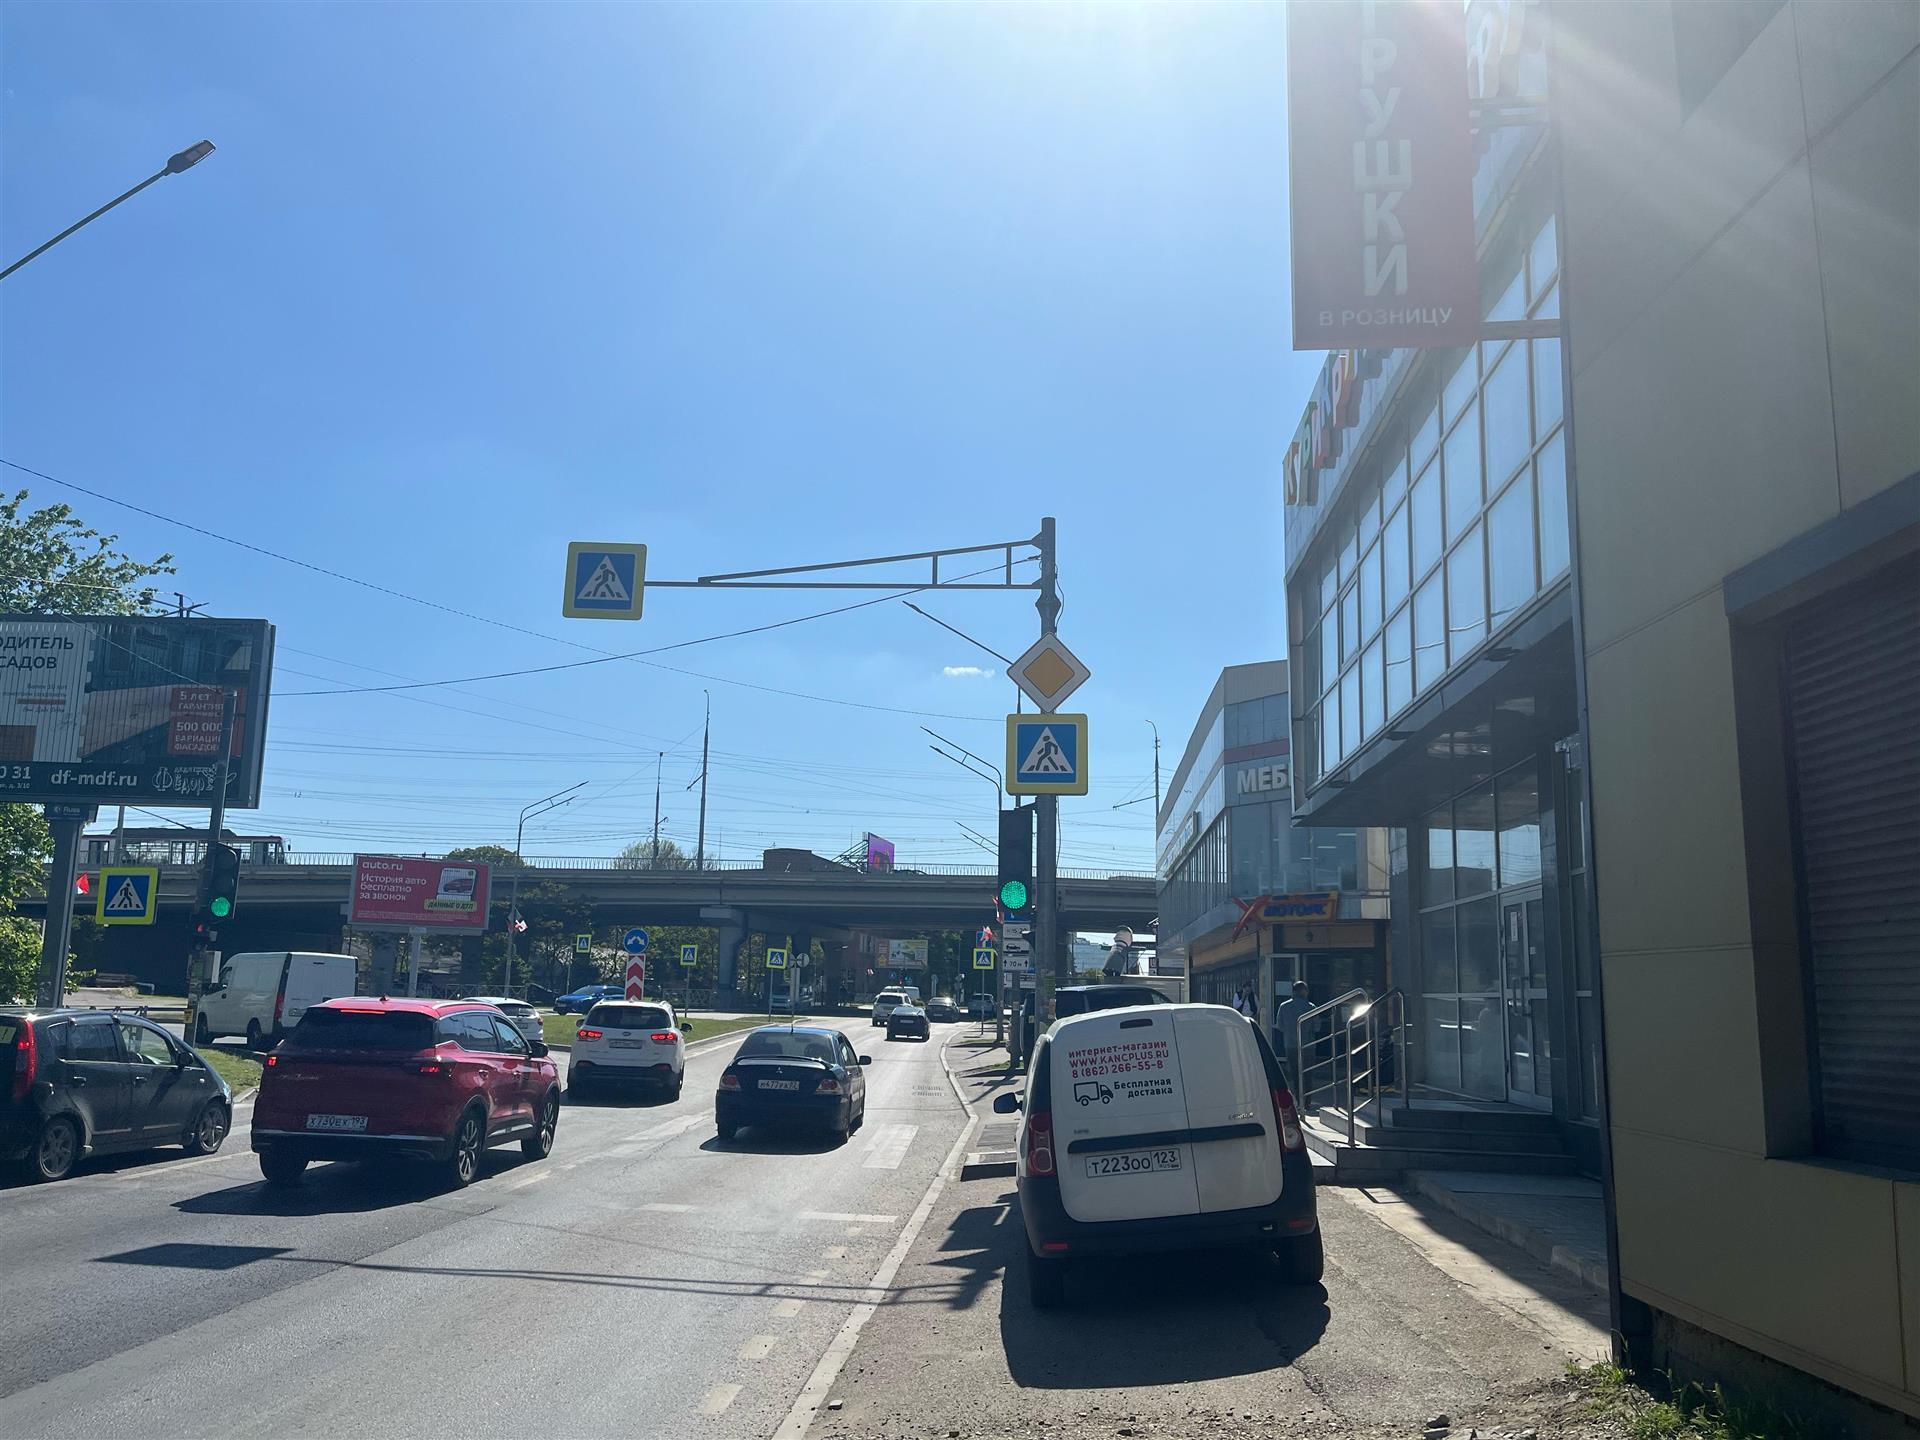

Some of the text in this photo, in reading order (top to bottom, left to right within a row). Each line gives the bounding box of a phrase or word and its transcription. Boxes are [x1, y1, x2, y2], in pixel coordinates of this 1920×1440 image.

[1319, 307, 1453, 327] В РОЗНИЦУ
[0, 636, 74, 651] ДИТЕЛЬ
[176, 721, 199, 732] 500
[12, 766, 31, 779] 31
[51, 769, 138, 786] df-mdf.ru
[1237, 763, 1291, 795] МЕБ
[362, 861, 403, 871] auto.ru
[361, 873, 427, 886] История авто
[1069, 1041, 1167, 1058] интернет-магазин
[1070, 1050, 1169, 1068] WWW.KANCPLUS.RU
[1072, 1060, 1164, 1078] 8 (862) 266-55-8
[1114, 1079, 1172, 1090] Бесплатная
[1128, 1087, 1173, 1098] доставка
[1153, 1151, 1176, 1164] 123
